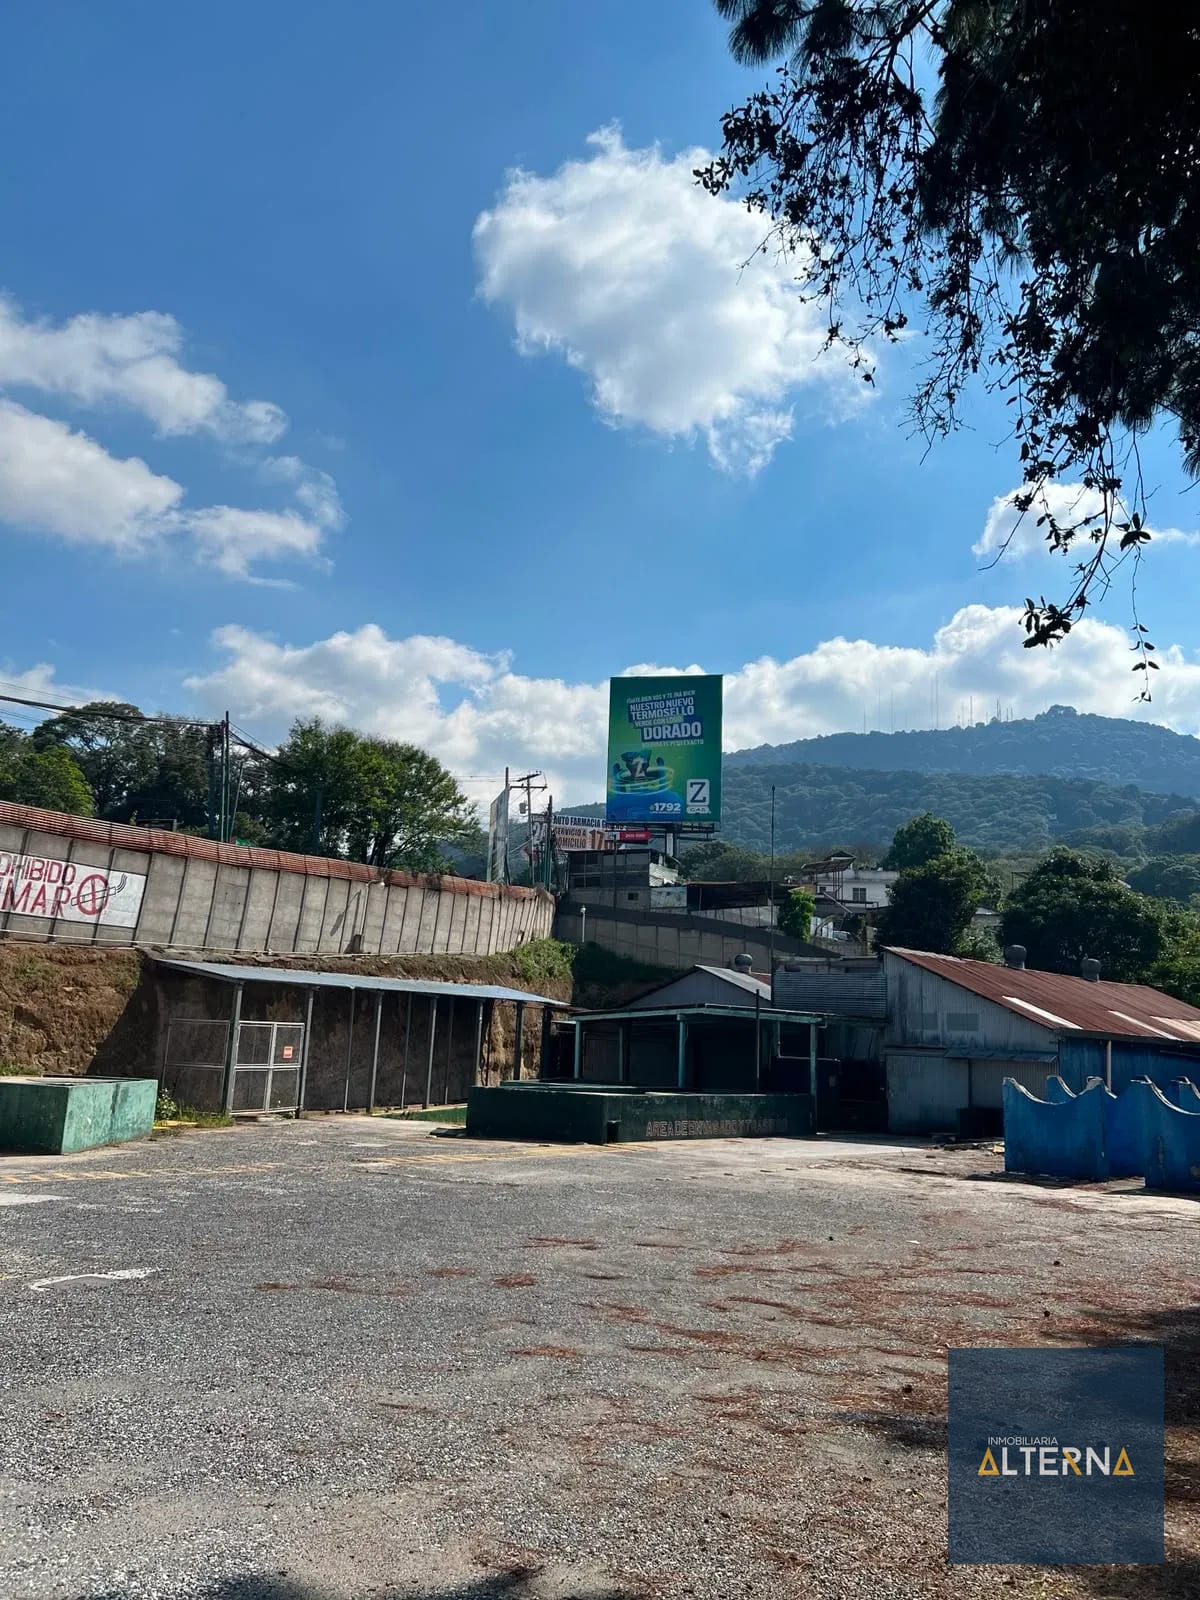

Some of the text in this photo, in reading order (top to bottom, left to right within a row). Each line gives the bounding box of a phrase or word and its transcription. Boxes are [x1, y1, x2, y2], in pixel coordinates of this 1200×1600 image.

[630, 700, 665, 712] NUESTRO
[666, 697, 694, 708] NUEVO
[631, 706, 695, 721] TERMOSELLO
[643, 721, 702, 740] DORADO
[690, 782, 706, 803] Z
[654, 803, 681, 811] 1792
[553, 815, 570, 825] AUTO
[571, 817, 600, 828] FARMACIA
[645, 1121, 674, 1137] AREA
[674, 1120, 688, 1136] DE
